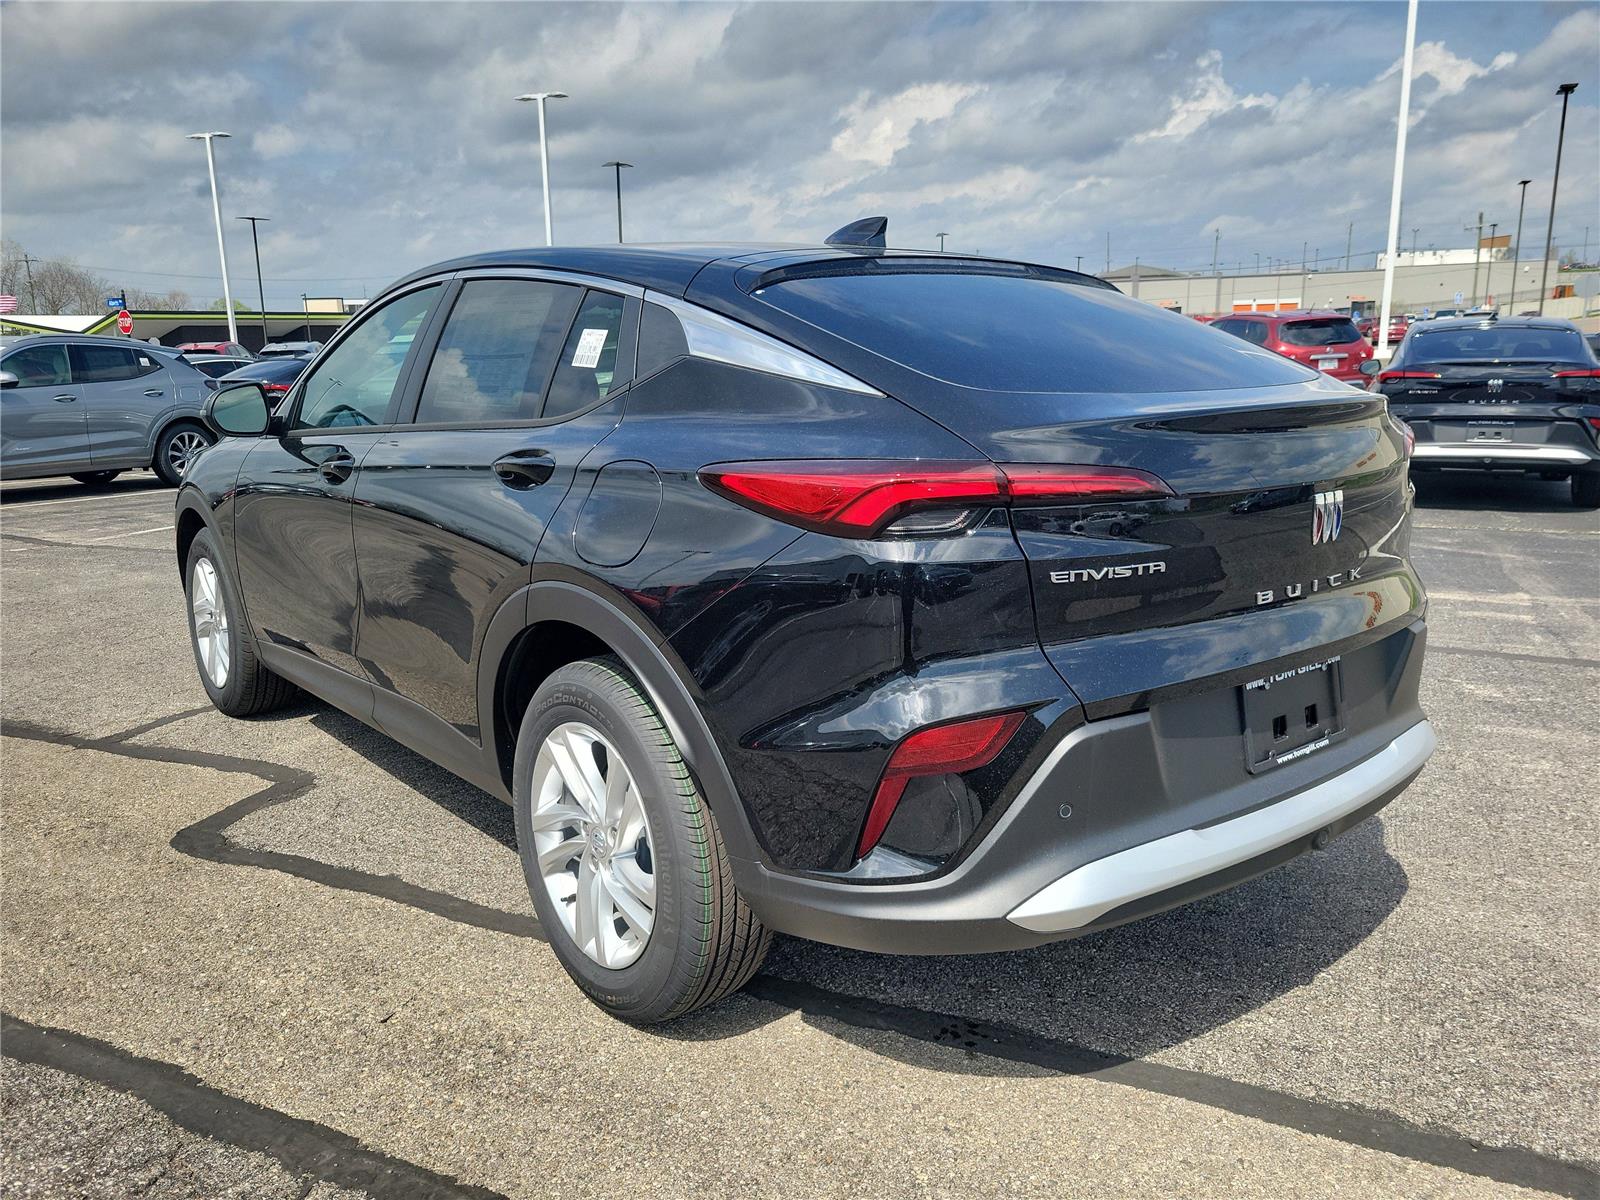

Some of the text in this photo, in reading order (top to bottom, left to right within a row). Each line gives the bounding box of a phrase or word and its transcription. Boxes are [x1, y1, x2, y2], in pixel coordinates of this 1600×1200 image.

[119, 317, 131, 327] STOP
[1050, 561, 1166, 584] ENVISTA
[1256, 567, 1361, 605] BUICK
[1276, 739, 1329, 764] www.tomgill.com
